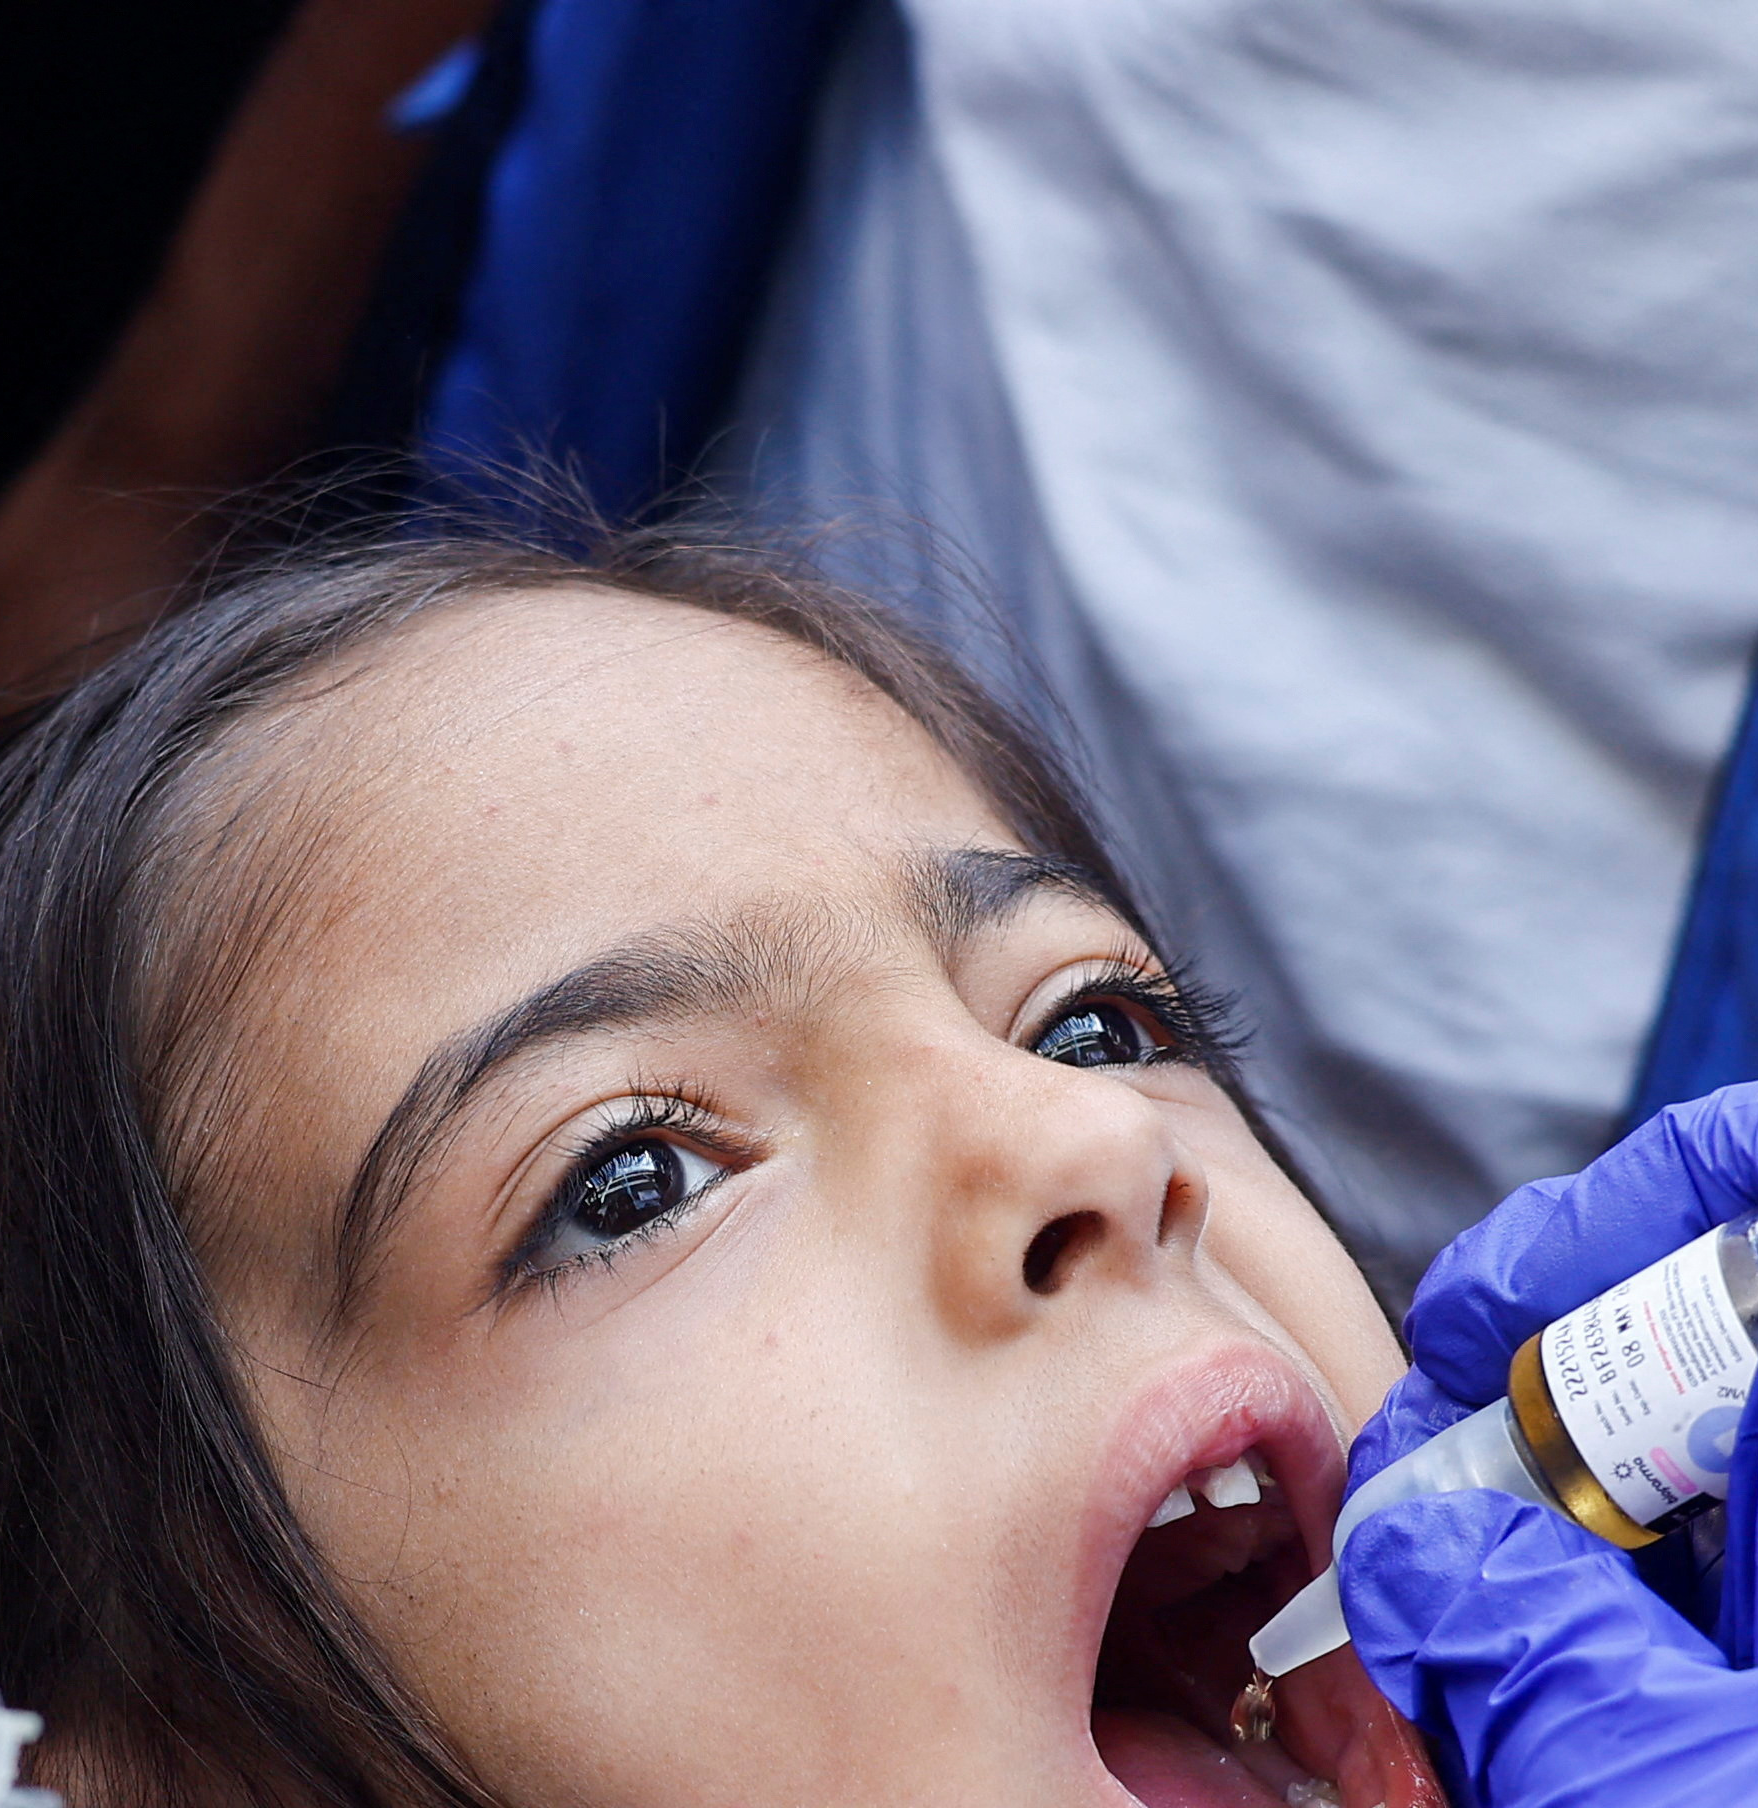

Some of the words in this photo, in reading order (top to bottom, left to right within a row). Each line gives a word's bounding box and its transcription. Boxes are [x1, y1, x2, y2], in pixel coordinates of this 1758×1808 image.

[1615, 1303, 1633, 1333] MAY
[1621, 1340, 1645, 1368] 08
[1633, 1456, 1678, 1505] biofarma
